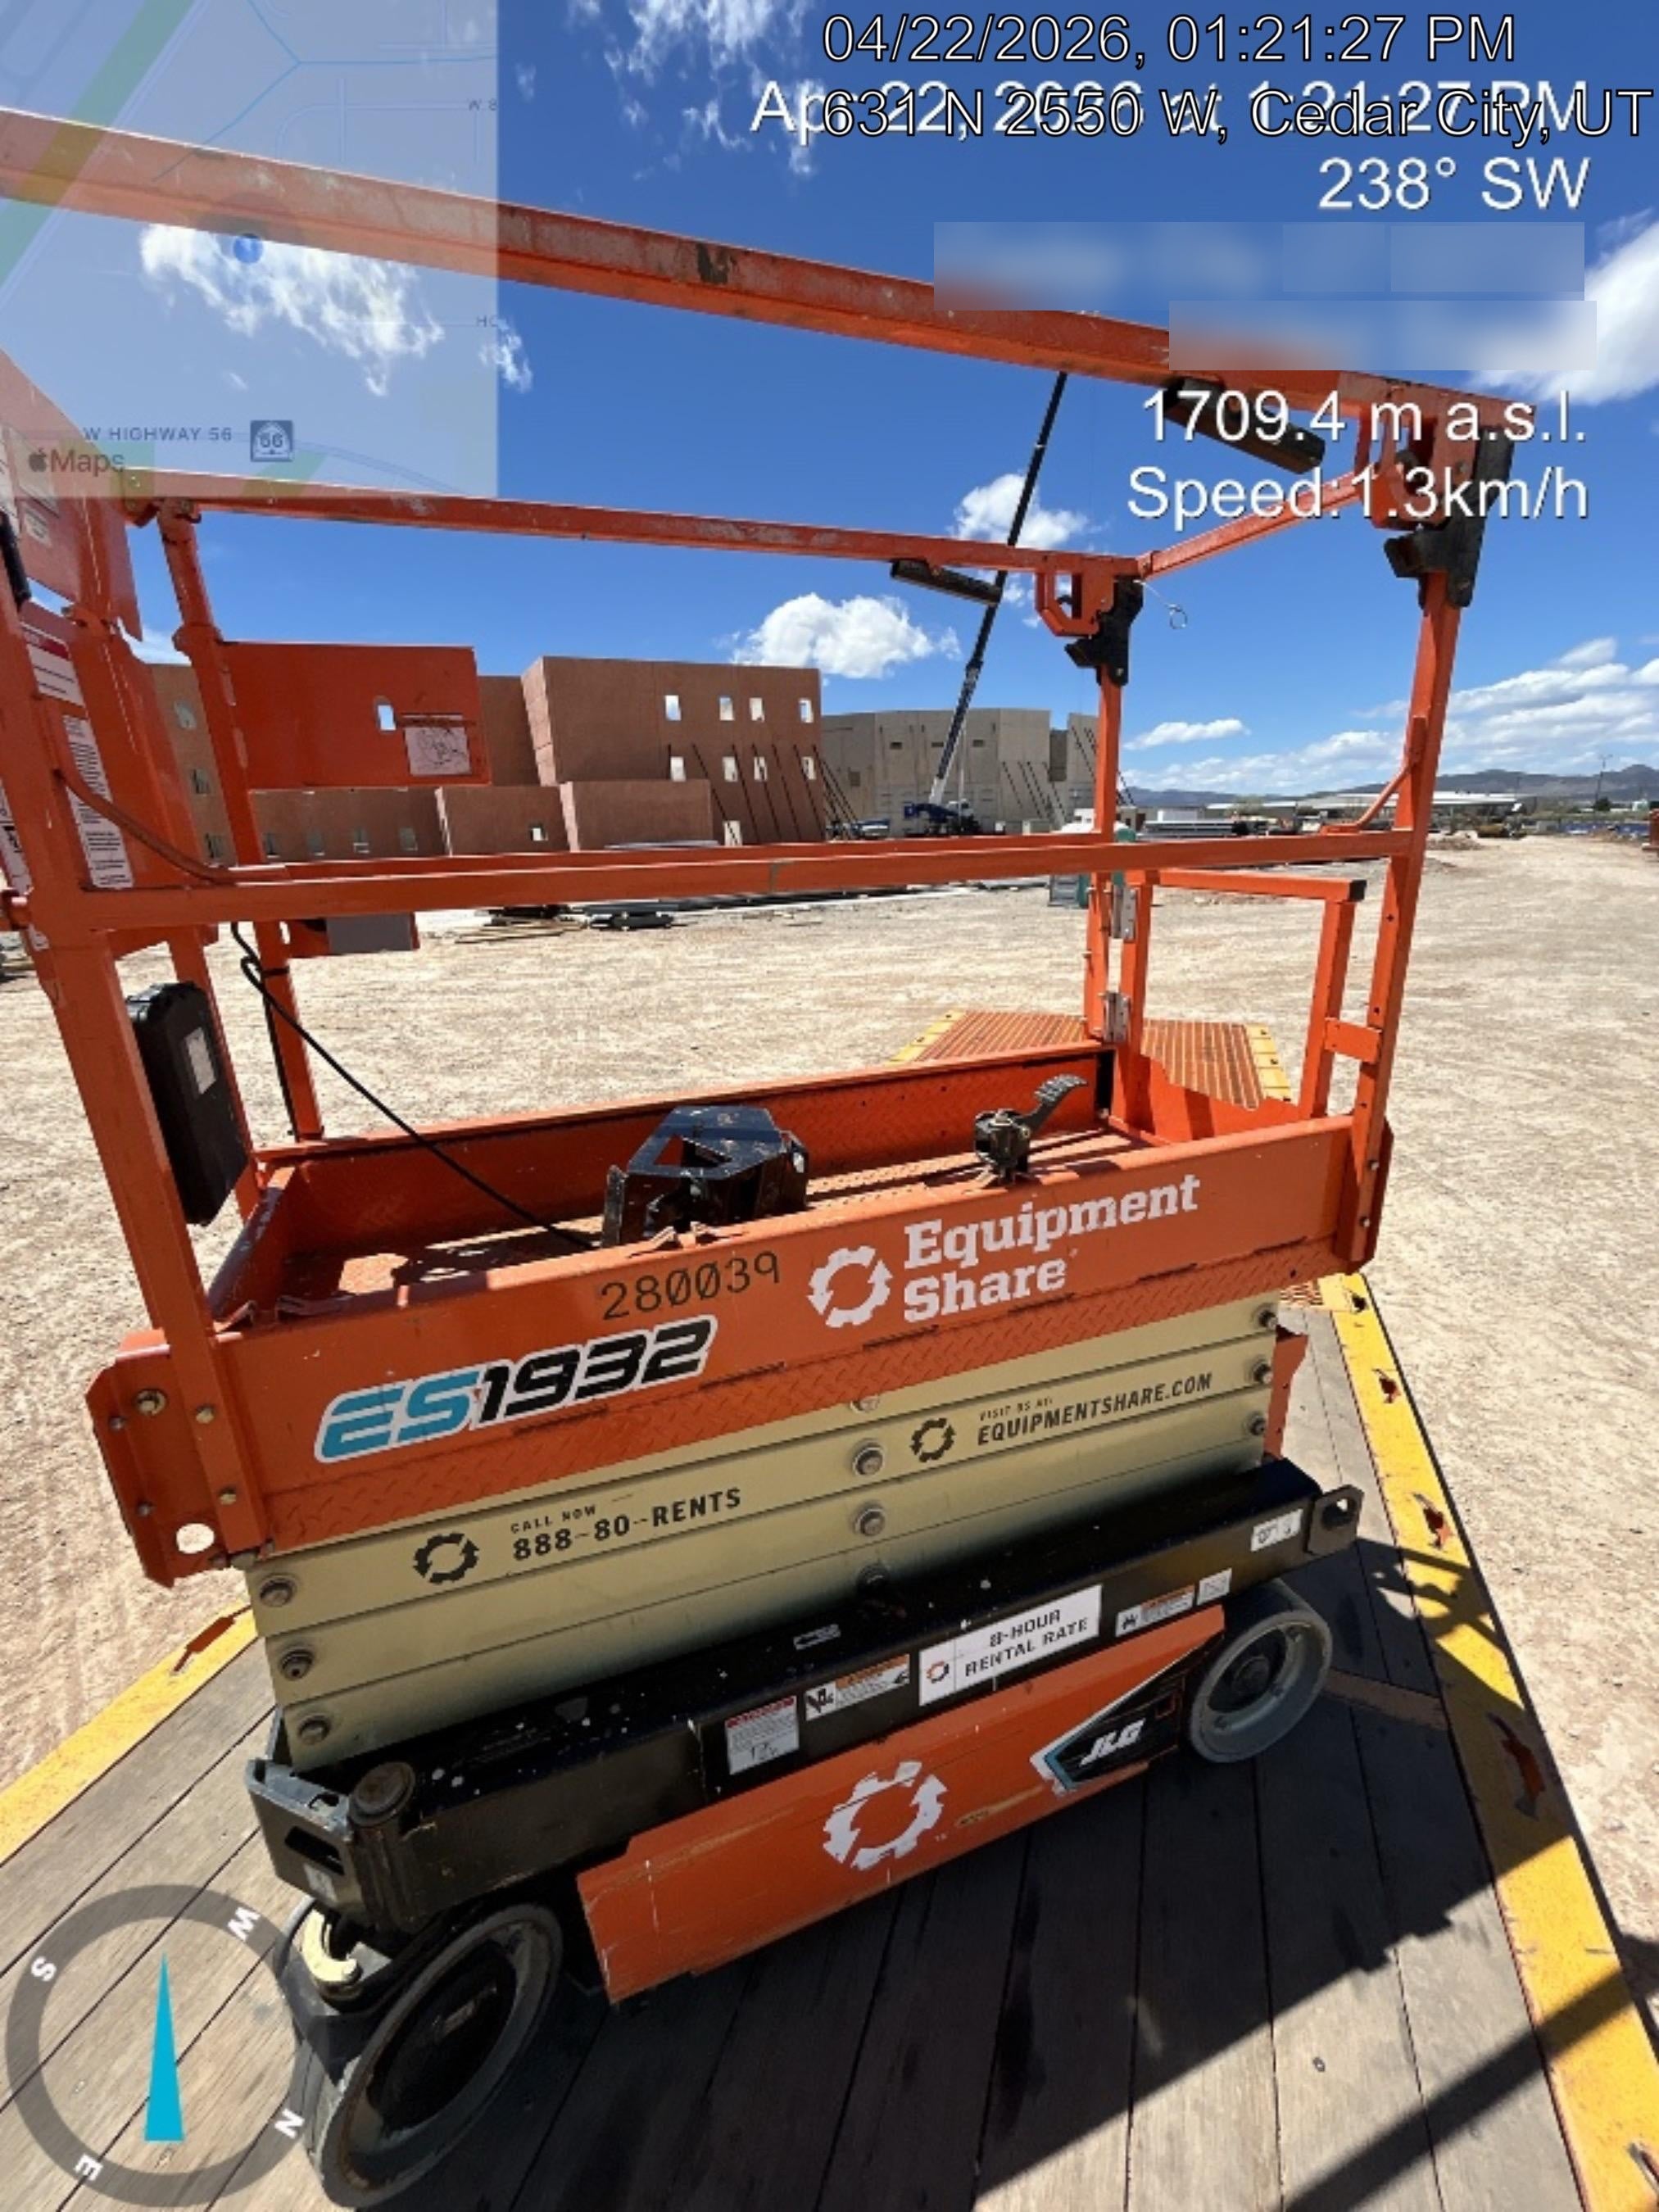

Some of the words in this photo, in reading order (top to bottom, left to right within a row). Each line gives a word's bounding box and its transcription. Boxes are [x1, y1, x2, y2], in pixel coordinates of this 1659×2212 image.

[904, 1174, 1201, 1270] Equipment
[601, 1250, 780, 1321] 280039
[904, 1258, 1067, 1322] Share
[316, 1316, 717, 1462] ES1932
[977, 1371, 1213, 1446] EQUIPMENTSHARE.COM
[510, 1515, 553, 1534] CALL
[561, 1505, 596, 1523] NOW
[513, 1489, 741, 1562] 888-80-RENTS
[965, 1639, 1037, 1677] RENTAL
[1041, 1616, 1089, 1646] RATE
[990, 1609, 1061, 1648] 8-HOUR
[1078, 1717, 1147, 1768] JLG
